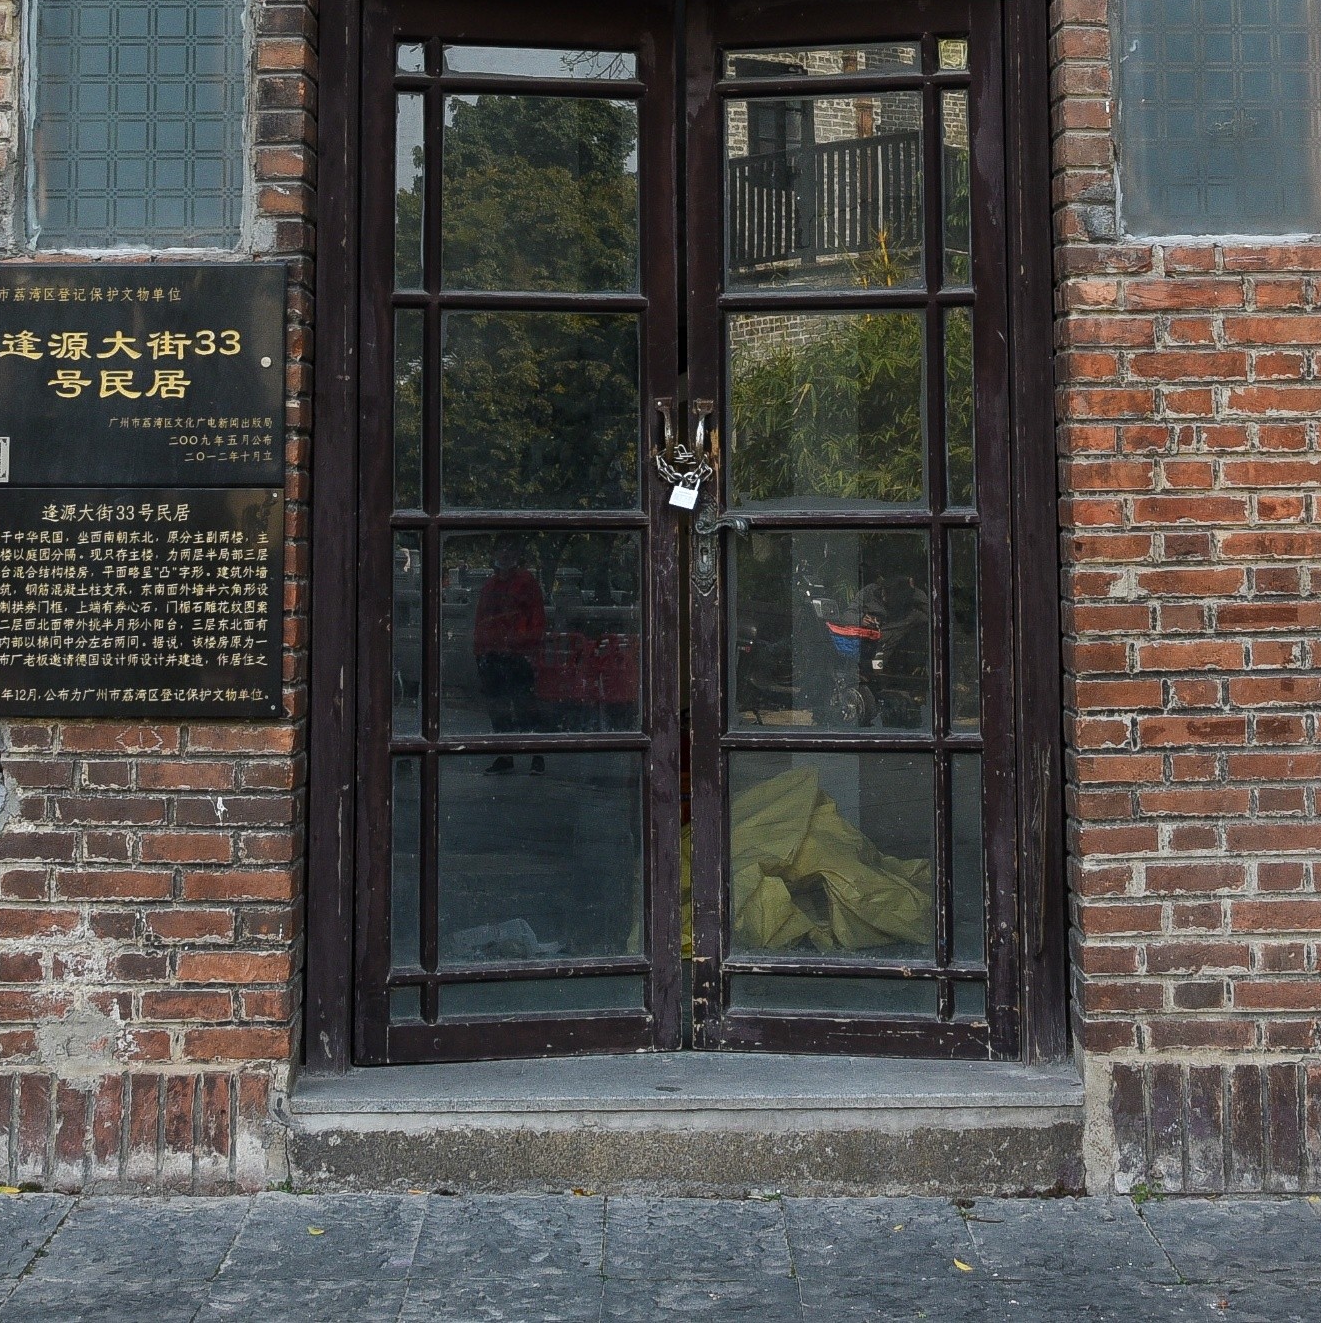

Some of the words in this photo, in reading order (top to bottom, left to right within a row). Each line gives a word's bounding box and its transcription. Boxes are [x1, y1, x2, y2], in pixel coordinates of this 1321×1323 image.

[47, 369, 192, 399] 号民居
[108, 417, 273, 429] 广州市荔湾区文化广电新闻出版局
[41, 503, 191, 522] 逢源大街33号民居
